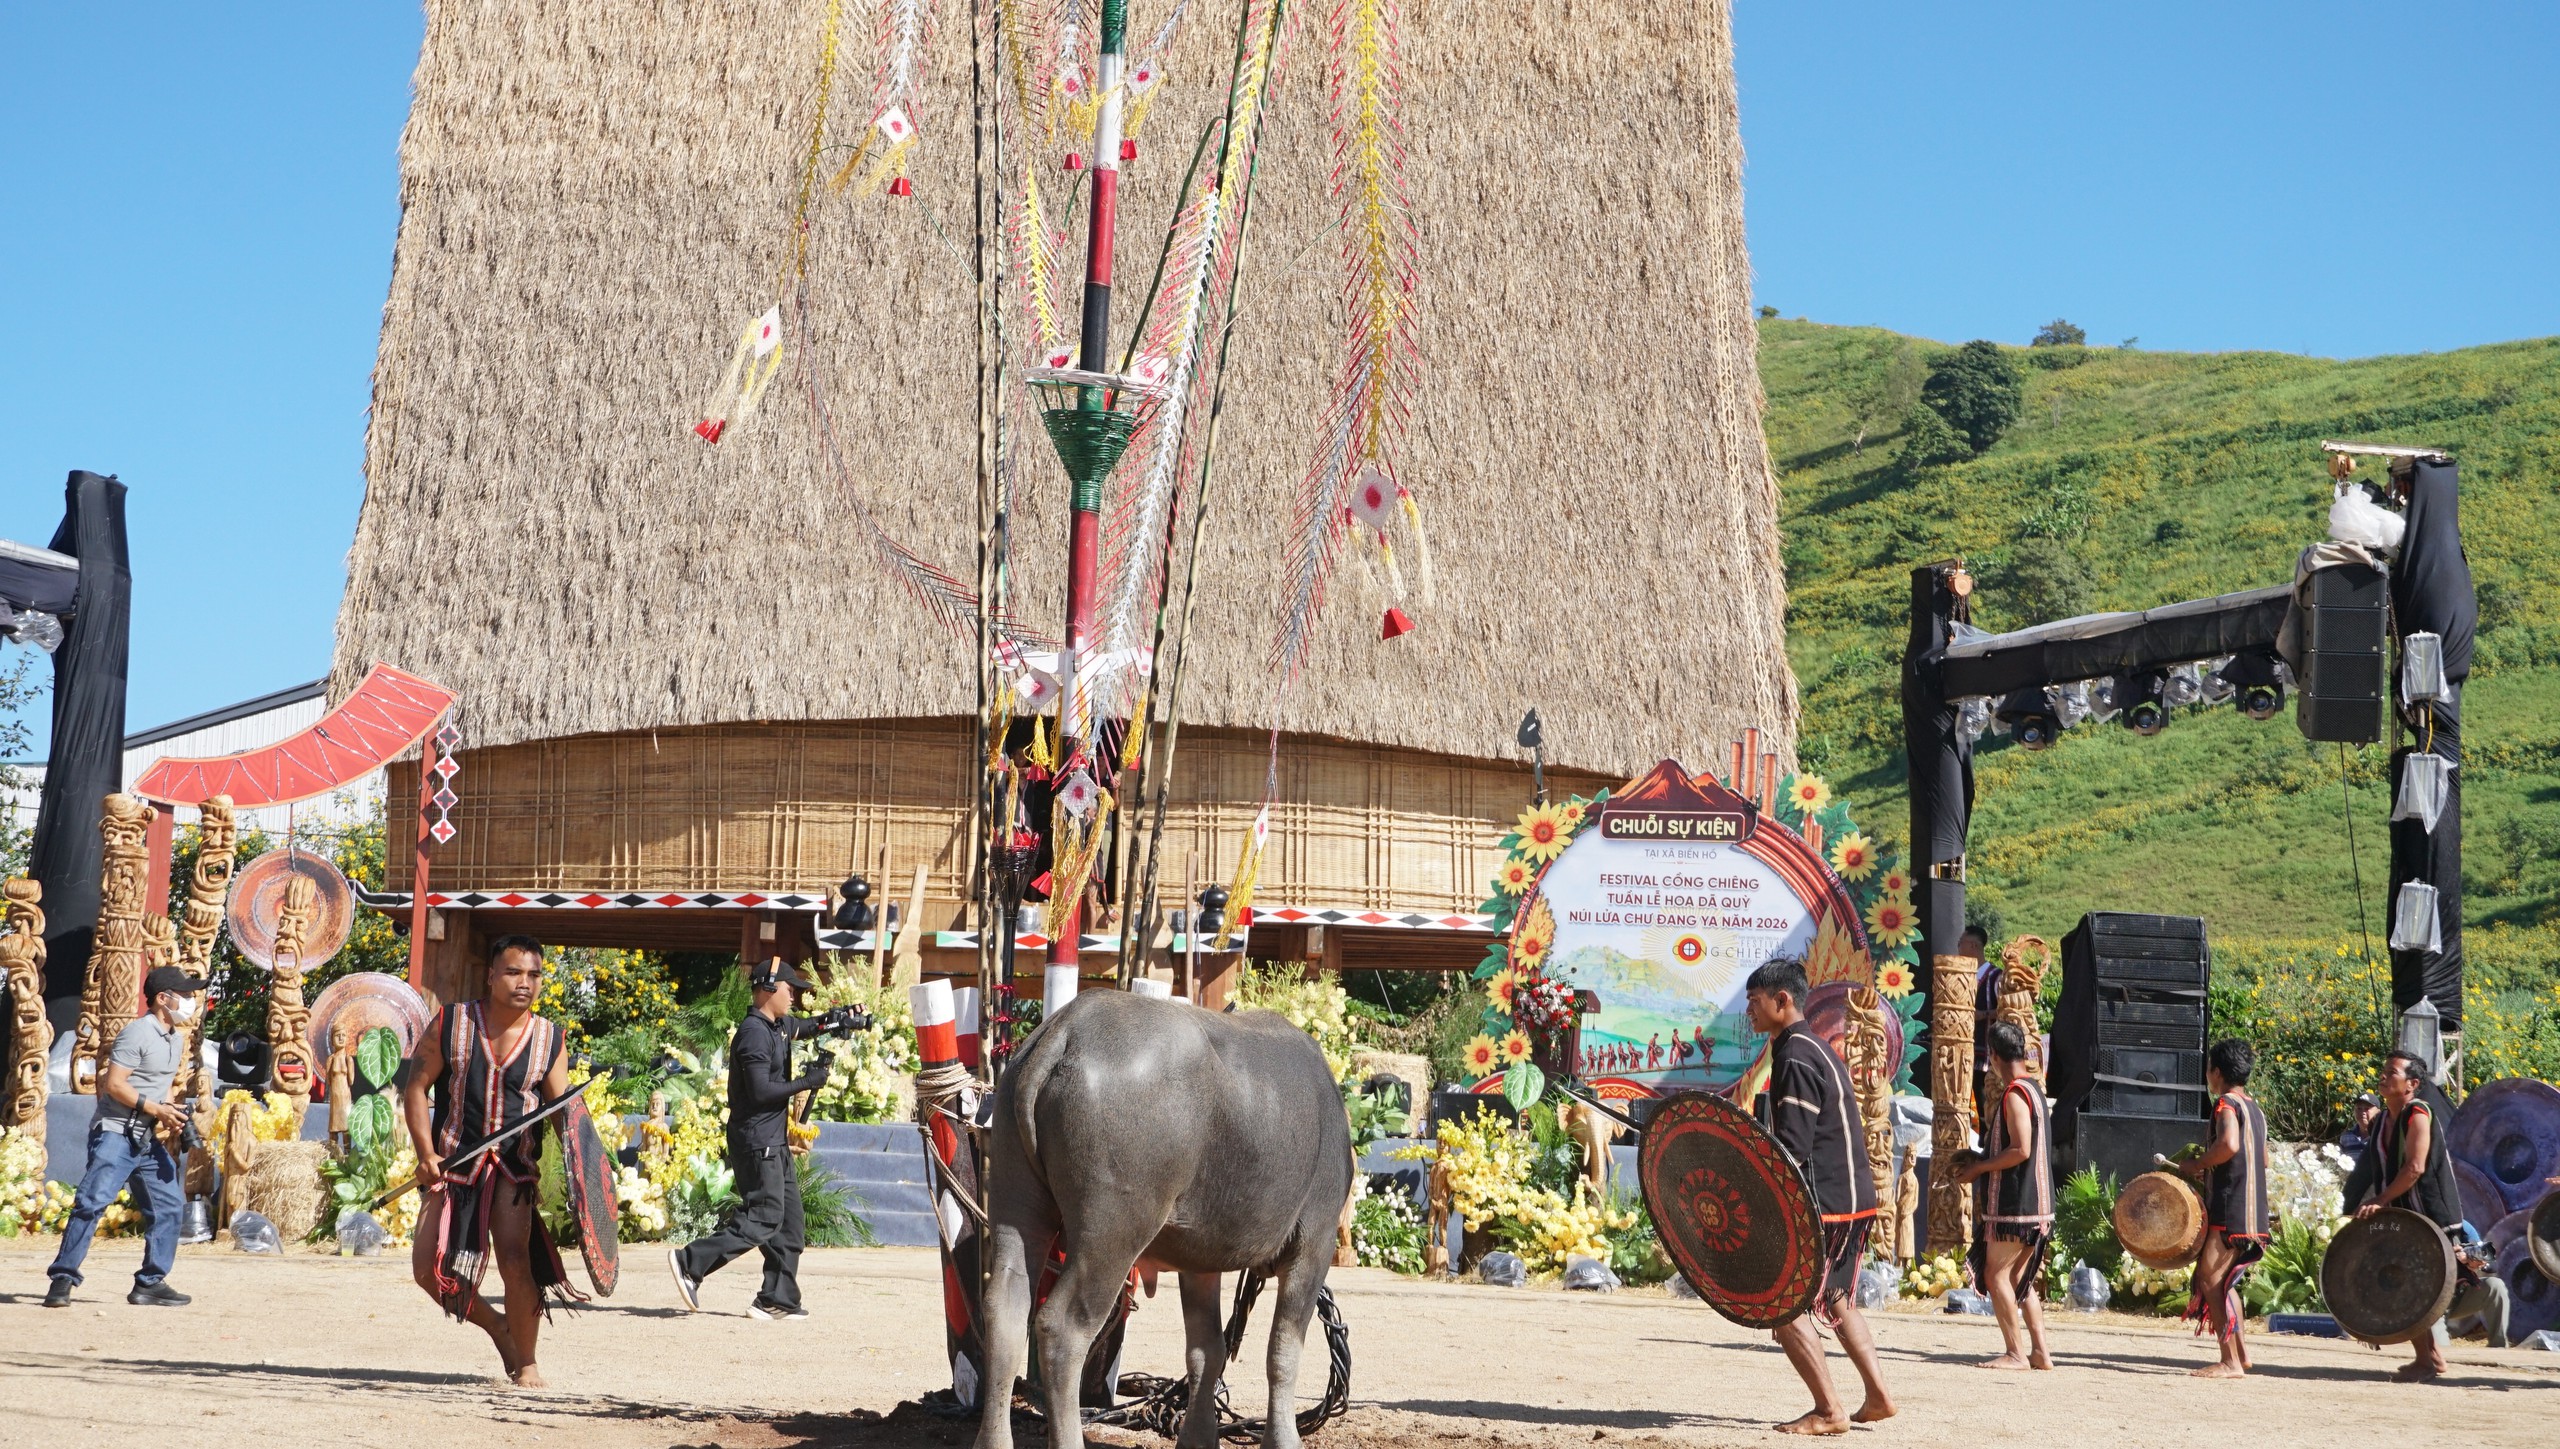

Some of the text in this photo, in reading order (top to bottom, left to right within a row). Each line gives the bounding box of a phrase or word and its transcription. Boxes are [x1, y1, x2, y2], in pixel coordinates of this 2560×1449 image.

[1610, 814, 1736, 840] CHUỖI SỰ KIỆN
[1644, 848, 1659, 860] TẠI
[1662, 847, 1675, 858] XÃ
[1599, 873, 1659, 886] FESTIVAL
[1708, 875, 1760, 890] CHIÊNG
[1647, 889, 1661, 905] LỄ
[1665, 894, 1694, 907] HOA
[1698, 893, 1717, 907] DÃ
[1721, 894, 1750, 908] QUỲ
[1569, 908, 1788, 929] NÚI LỬA CHƯ ĐANG YA NĂM 2026
